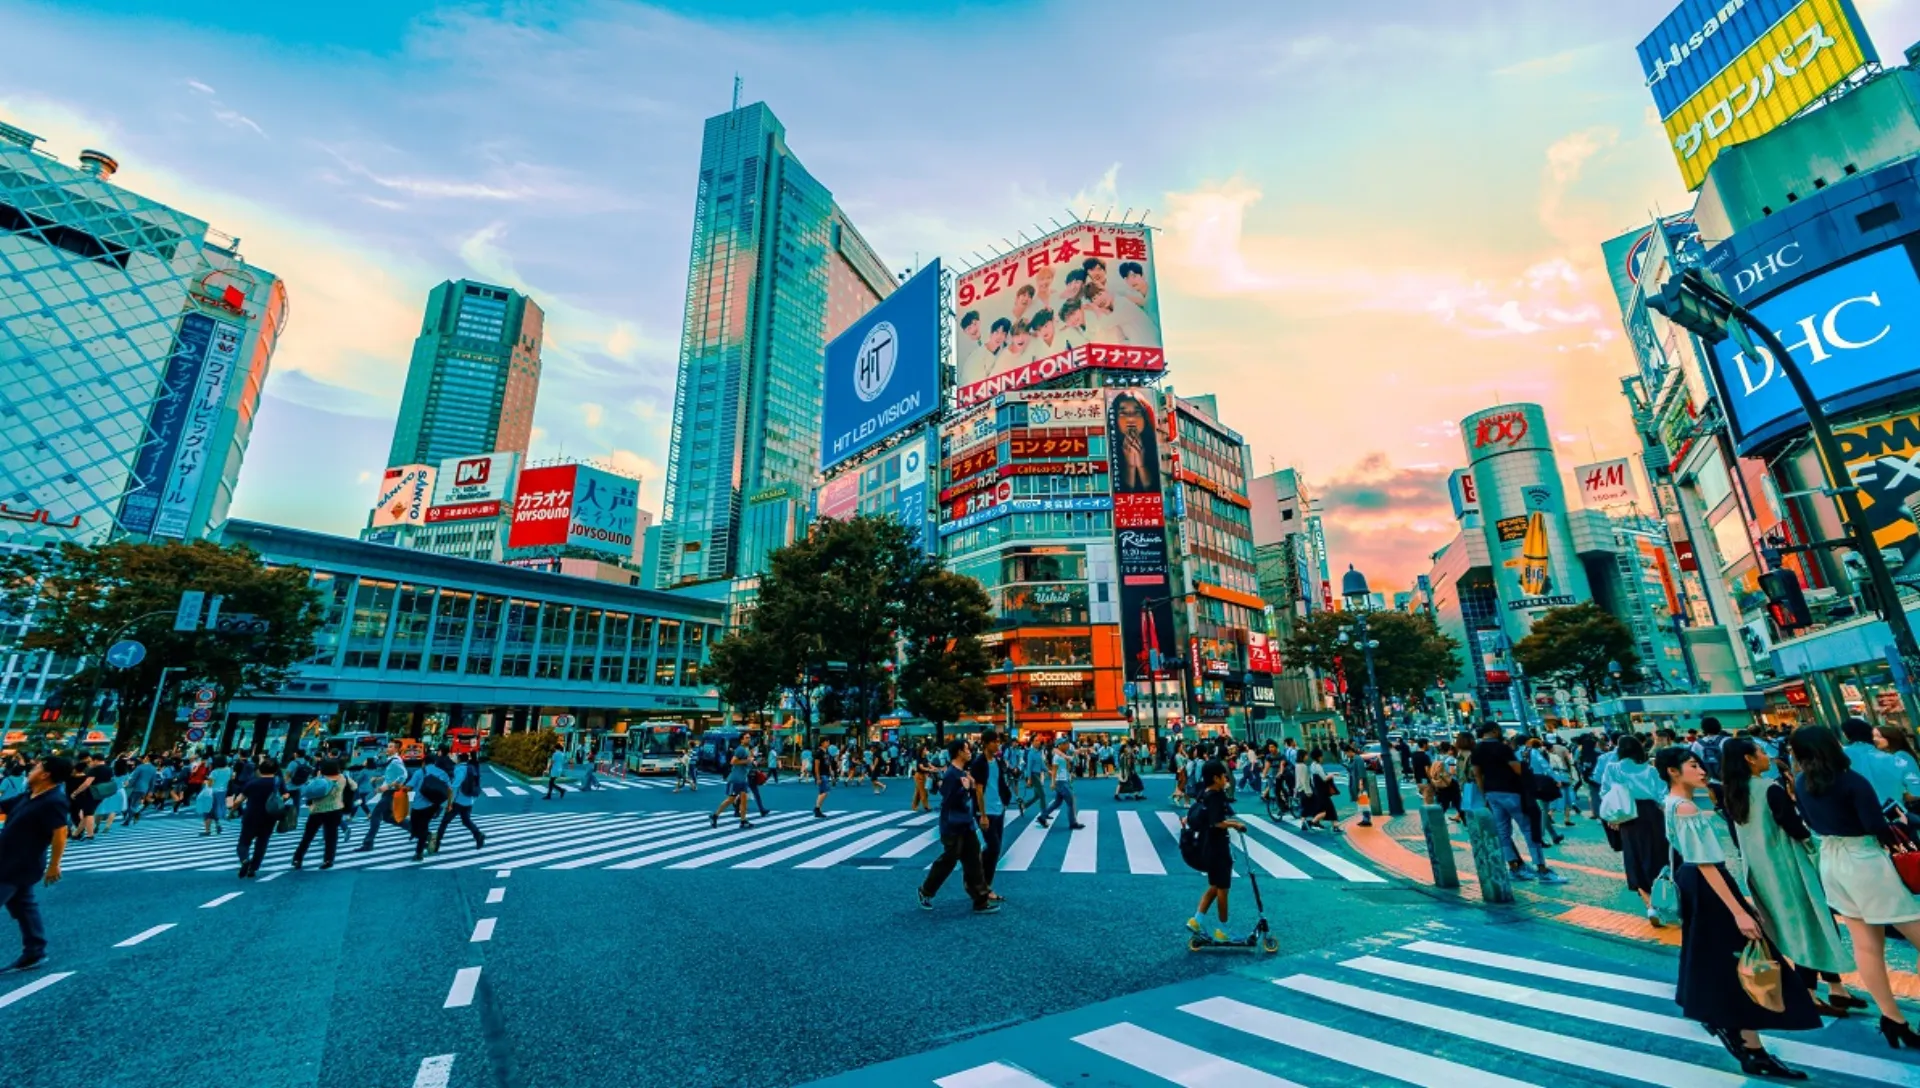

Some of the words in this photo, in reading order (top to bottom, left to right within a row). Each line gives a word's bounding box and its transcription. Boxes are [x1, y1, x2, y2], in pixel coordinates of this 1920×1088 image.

[1675, 21, 1837, 160] サロンパス
[959, 262, 1019, 307] 9.27
[1026, 234, 1148, 278] 日本上陸
[1733, 241, 1804, 295] DHC
[1091, 347, 1161, 366] ワナワン
[1731, 290, 1891, 398] DHC
[833, 431, 852, 455] HIT
[853, 417, 877, 444] LED
[876, 390, 921, 431] VISION
[1011, 438, 1085, 455] コンタクト
[1064, 461, 1099, 475] ガスト
[1584, 463, 1626, 492] H&M
[377, 471, 416, 508] SANKYO
[409, 470, 429, 520] SANKYO
[518, 489, 572, 510] カラオケ
[578, 478, 637, 512] 大声
[515, 507, 570, 523] JOYSOUND
[569, 523, 632, 546] JOYSOUND
